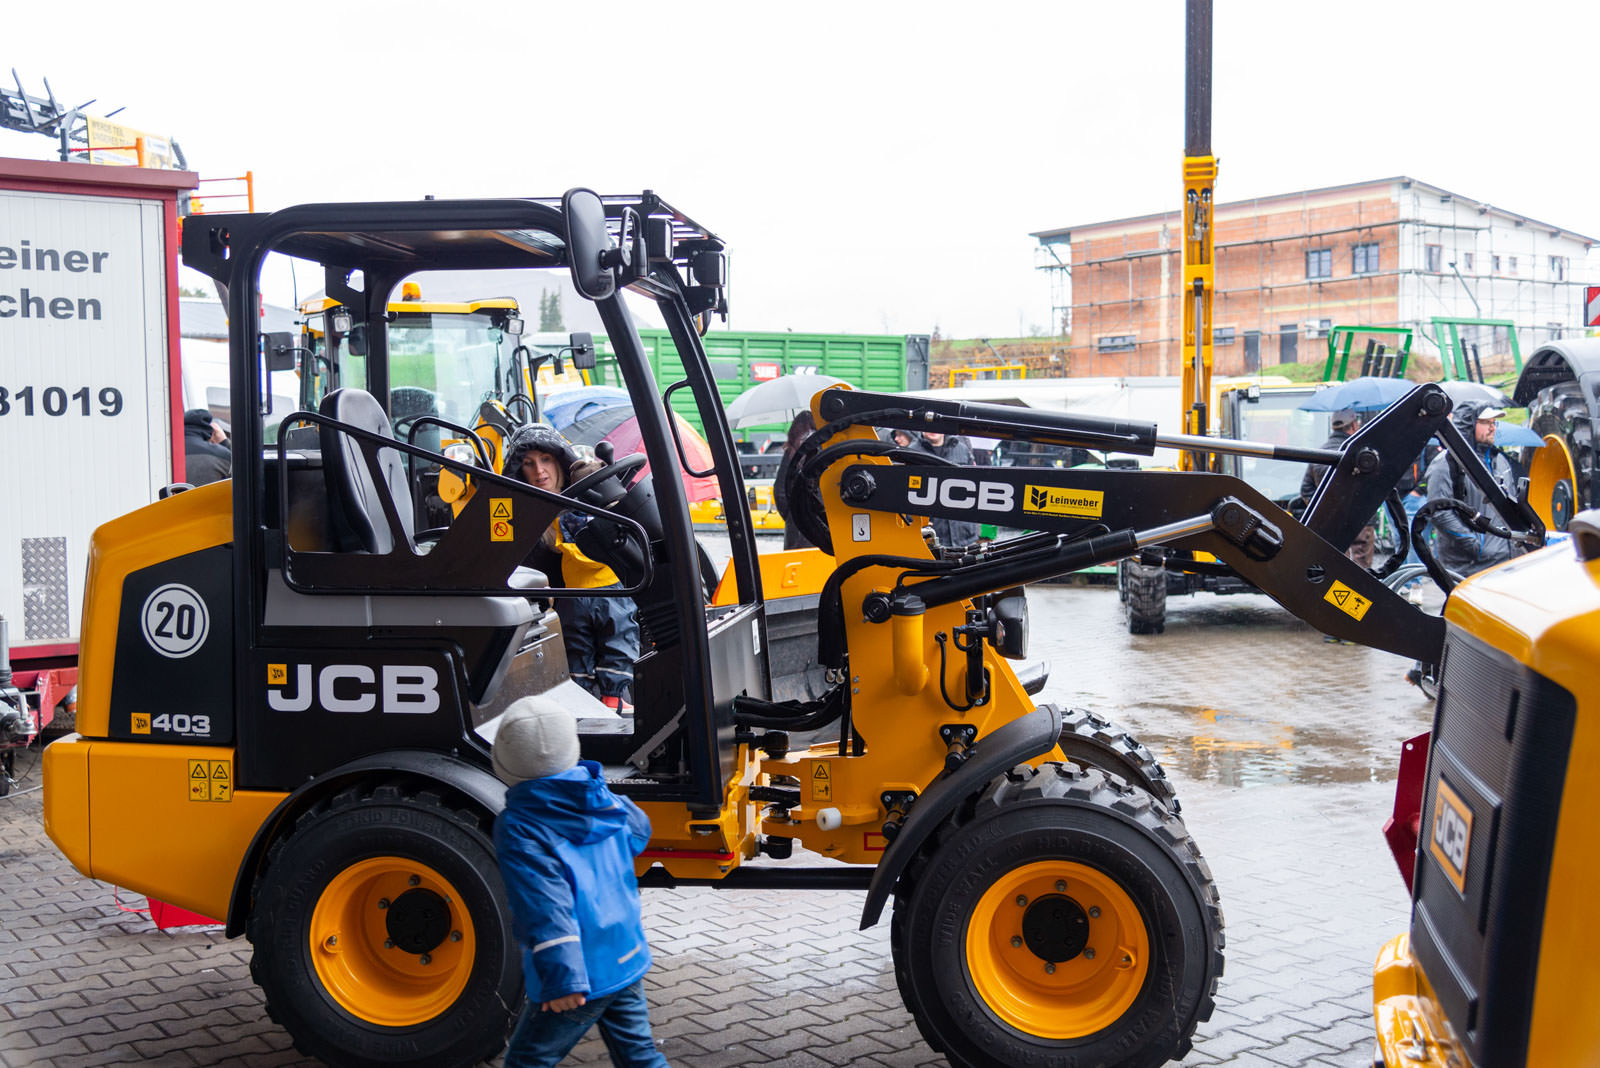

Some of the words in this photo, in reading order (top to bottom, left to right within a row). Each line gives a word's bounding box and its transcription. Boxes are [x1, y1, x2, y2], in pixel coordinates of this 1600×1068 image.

[908, 476, 1014, 512] JCB
[1050, 495, 1099, 507] Leinweber
[155, 601, 196, 640] 20
[268, 664, 440, 714] JCB
[152, 713, 211, 734] 403
[1434, 802, 1468, 872] JCB
